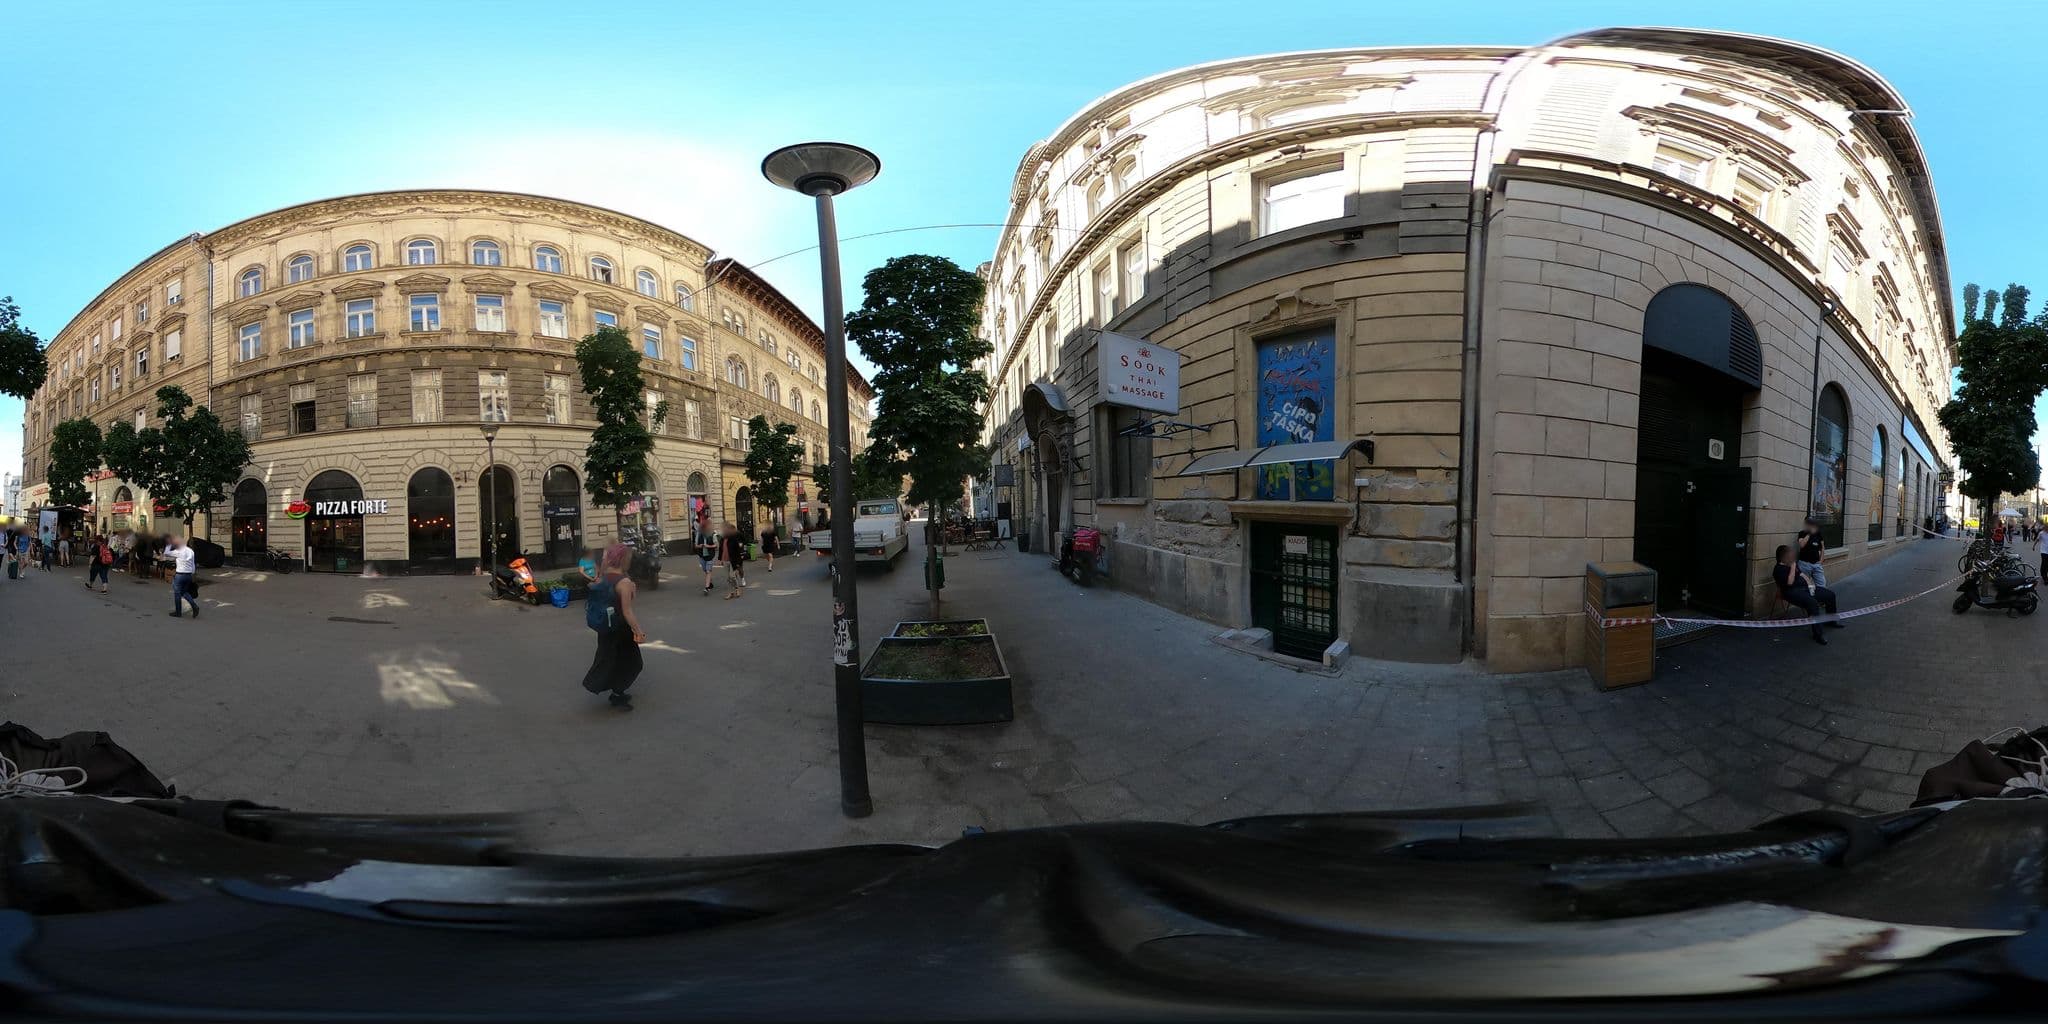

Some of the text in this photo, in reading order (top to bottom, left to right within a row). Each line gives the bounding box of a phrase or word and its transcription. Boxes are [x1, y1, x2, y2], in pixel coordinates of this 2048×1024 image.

[1120, 355, 1166, 376] SOOK
[1130, 375, 1157, 385] THAI
[1121, 386, 1165, 400] MASSAGE
[316, 501, 348, 515] PIZZA
[351, 499, 388, 514] FORTE
